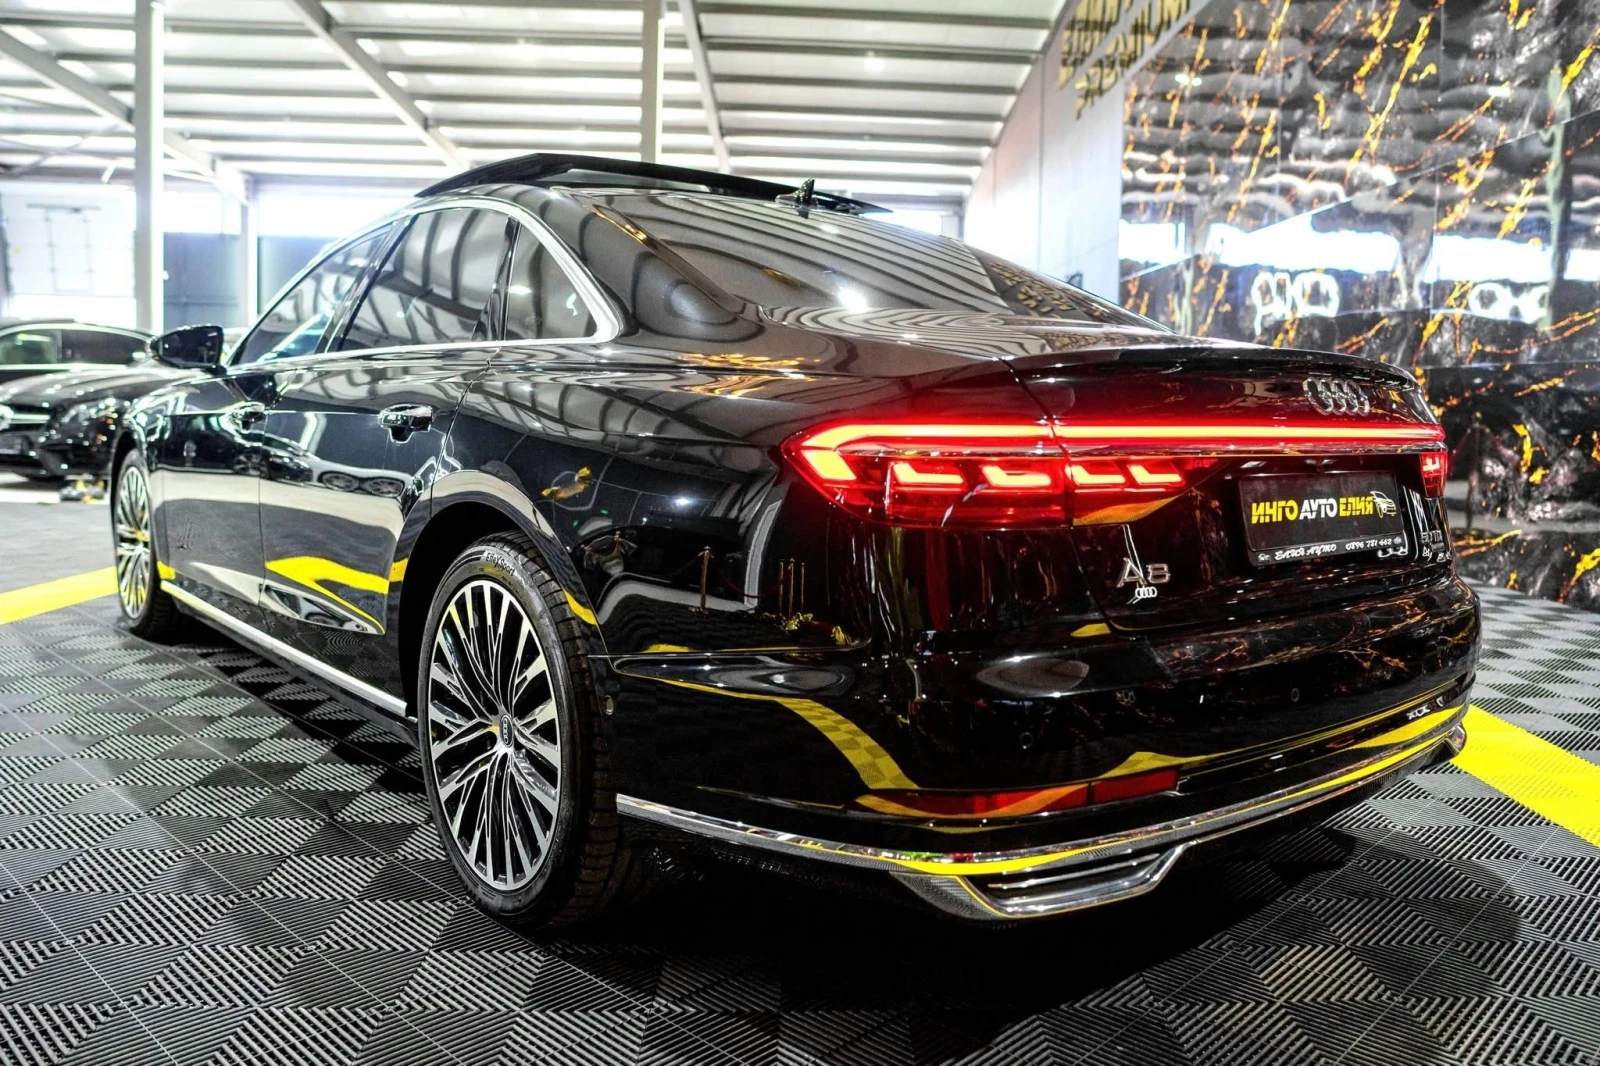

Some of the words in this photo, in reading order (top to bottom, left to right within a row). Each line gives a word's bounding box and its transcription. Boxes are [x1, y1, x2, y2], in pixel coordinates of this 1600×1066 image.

[1251, 499, 1299, 524] ИНГО
[1299, 497, 1338, 520] АУТО
[1339, 496, 1374, 517] ЕЛИЯ
[1345, 541, 1365, 551] 0896
[1116, 557, 1171, 588] A8
